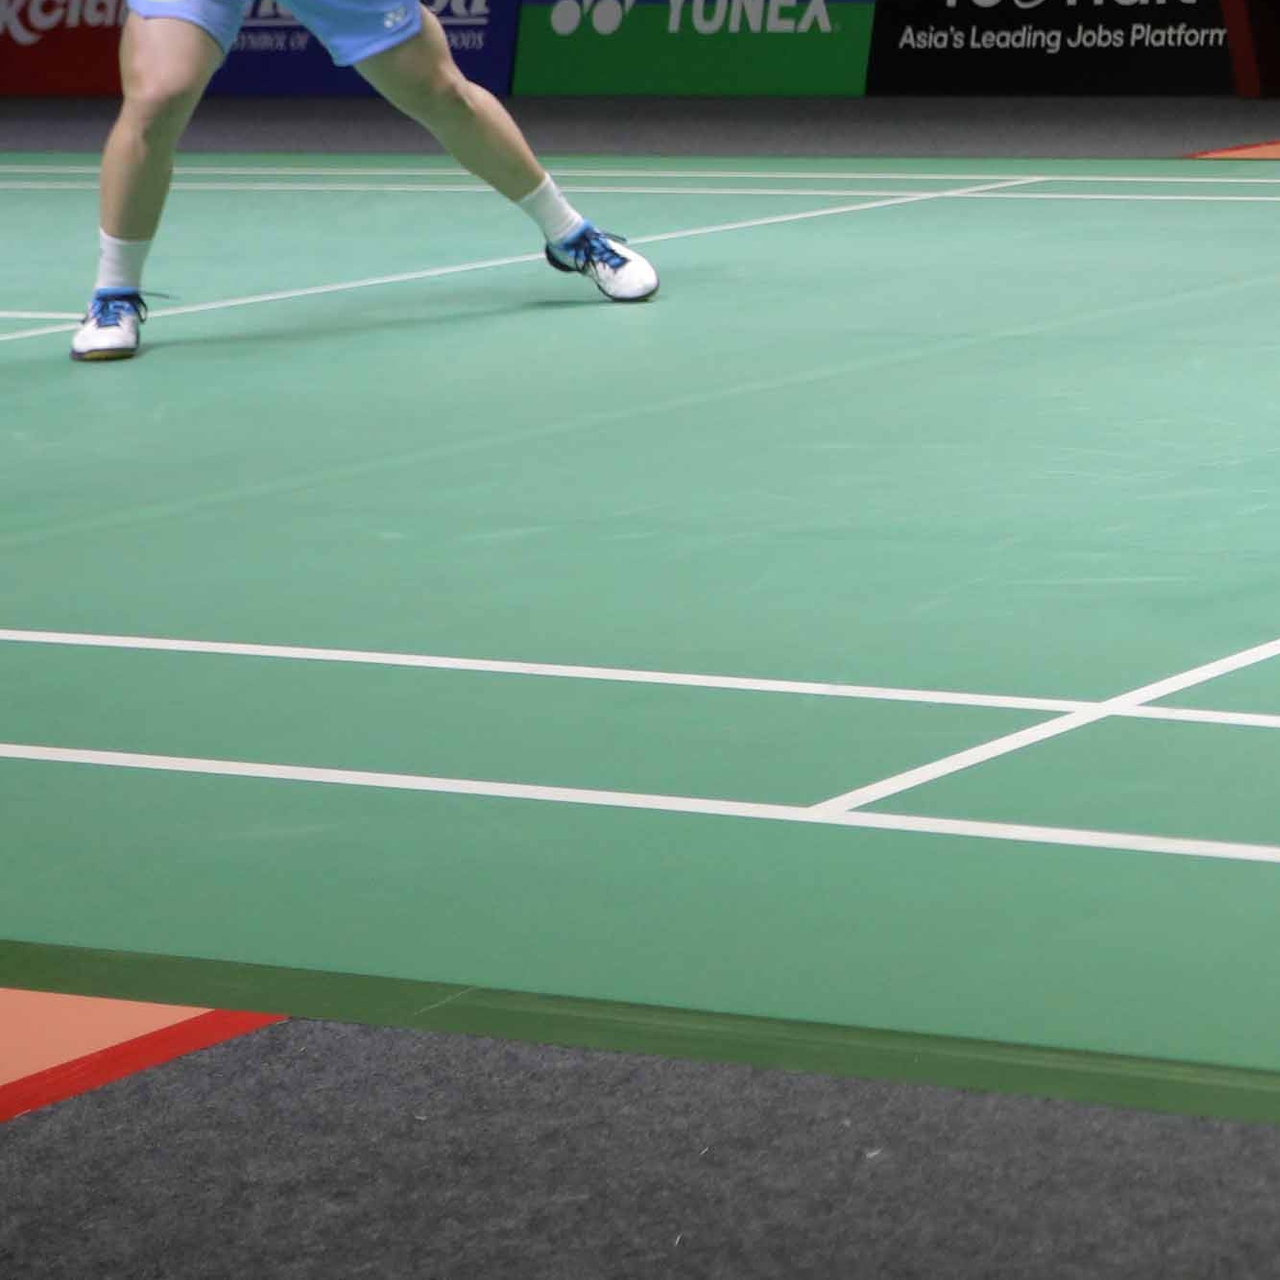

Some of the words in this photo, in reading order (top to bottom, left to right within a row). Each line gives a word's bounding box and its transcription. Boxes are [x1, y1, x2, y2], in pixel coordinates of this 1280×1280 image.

[899, 25, 965, 49] Asia's
[970, 26, 1062, 54] Leading
[1067, 25, 1124, 48] Jobs
